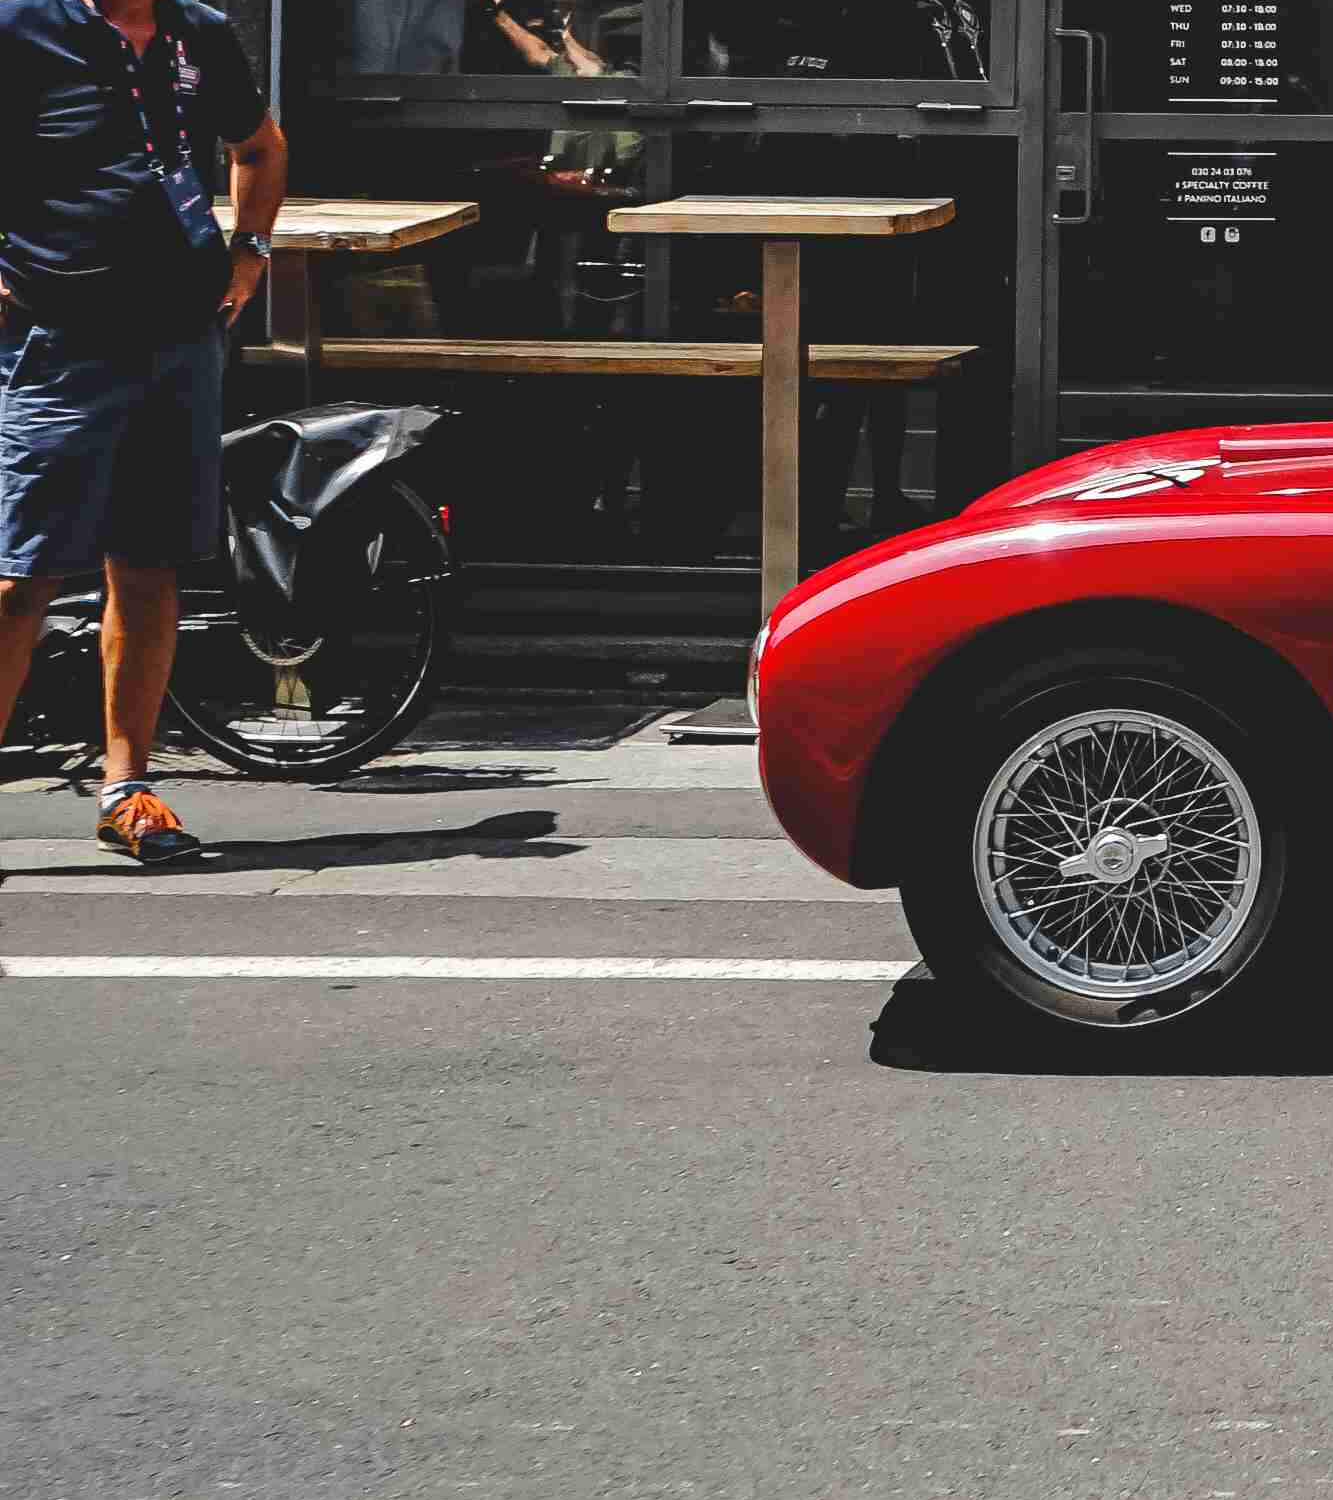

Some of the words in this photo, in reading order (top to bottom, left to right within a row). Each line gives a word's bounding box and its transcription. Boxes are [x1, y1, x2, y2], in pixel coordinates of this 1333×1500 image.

[1170, 4, 1193, 13] WED
[1170, 22, 1190, 31] THU
[1170, 39, 1185, 48] FRI
[1169, 57, 1187, 66] SAT
[1169, 75, 1190, 84] SUN
[1182, 181, 1230, 189] SPECIALTY
[1232, 181, 1270, 190] COFFEE
[1184, 194, 1222, 203] PANINO
[1223, 194, 1267, 203] ITALIANO
